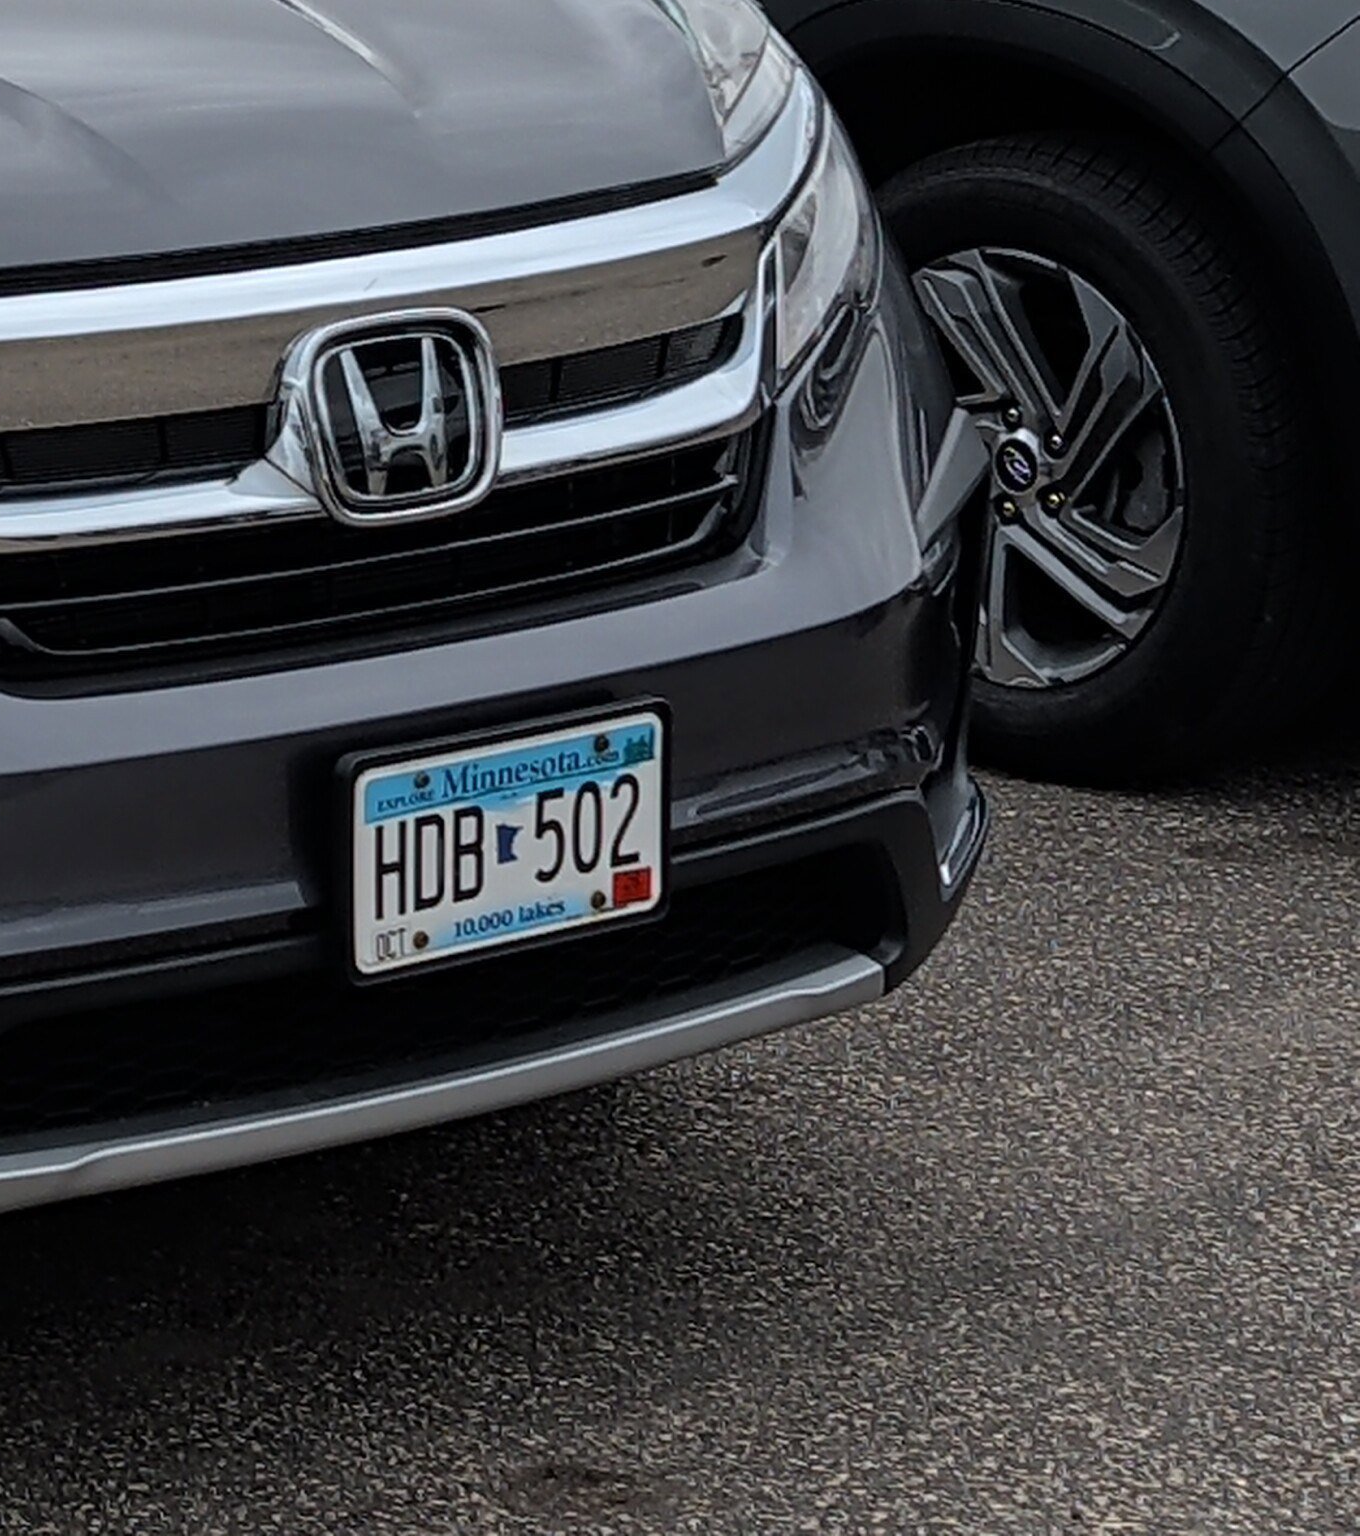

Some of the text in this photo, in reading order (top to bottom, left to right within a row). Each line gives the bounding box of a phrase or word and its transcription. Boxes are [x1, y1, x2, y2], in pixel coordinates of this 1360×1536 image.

[377, 789, 436, 813] EXPLORE
[374, 772, 641, 921] HDB 502
[454, 897, 567, 938] 10,000 lakes
[375, 927, 408, 961] OCT
